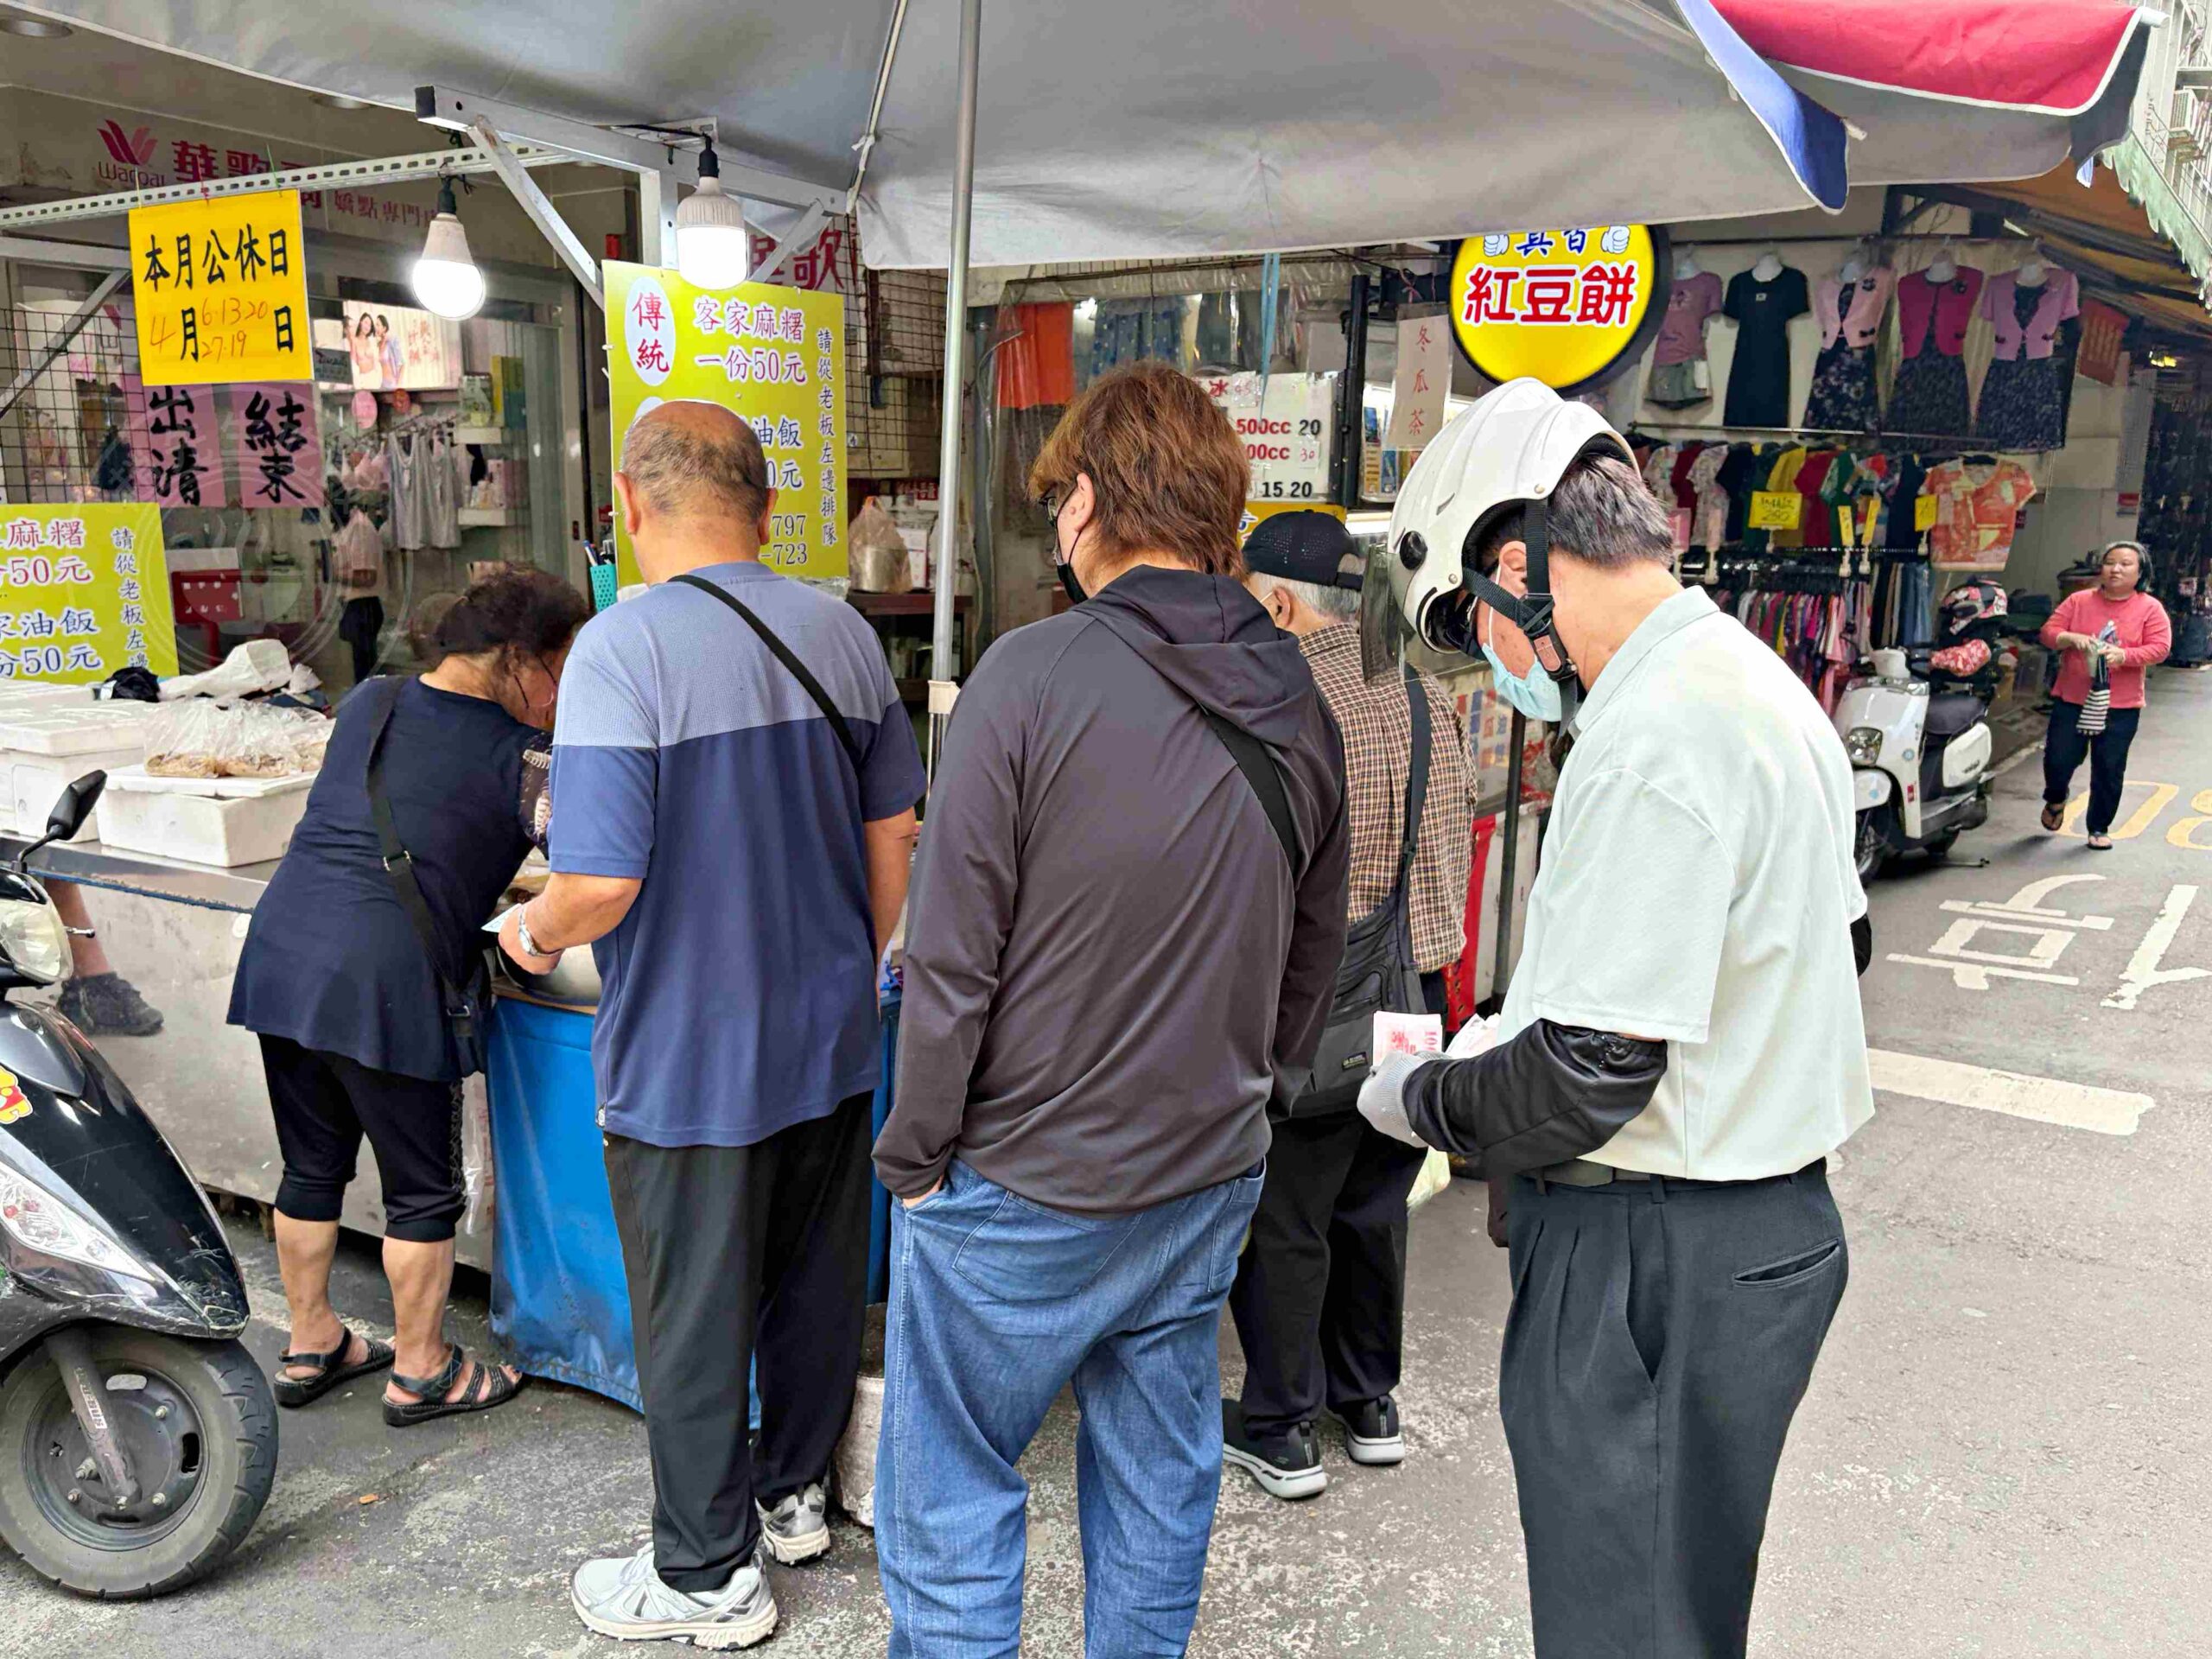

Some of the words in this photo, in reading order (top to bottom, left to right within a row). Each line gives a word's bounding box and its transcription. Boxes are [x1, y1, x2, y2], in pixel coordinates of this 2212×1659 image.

[143, 223, 289, 292] 本月公休日
[1465, 264, 1636, 325] 紅豆餅
[632, 292, 671, 373] 傳統
[696, 298, 804, 342] 客家麻糬
[695, 349, 807, 383] 一份50元
[1408, 325, 1432, 436] 冬瓜茶
[149, 385, 209, 506] 出清
[245, 390, 308, 504] 結束
[753, 417, 802, 448] 油飯
[817, 329, 837, 546] 請從老板左邊排隊
[1236, 418, 1291, 435] 500cc
[1299, 419, 1321, 436] 20
[1246, 443, 1290, 461] 00cc
[1300, 448, 1315, 462] 30
[766, 461, 803, 489] 0元
[1262, 481, 1283, 498] 15
[1290, 481, 1313, 498] 20
[0, 521, 84, 548] 麻糬
[0, 558, 92, 586] 50元
[1885, 873, 2212, 1011] 停
